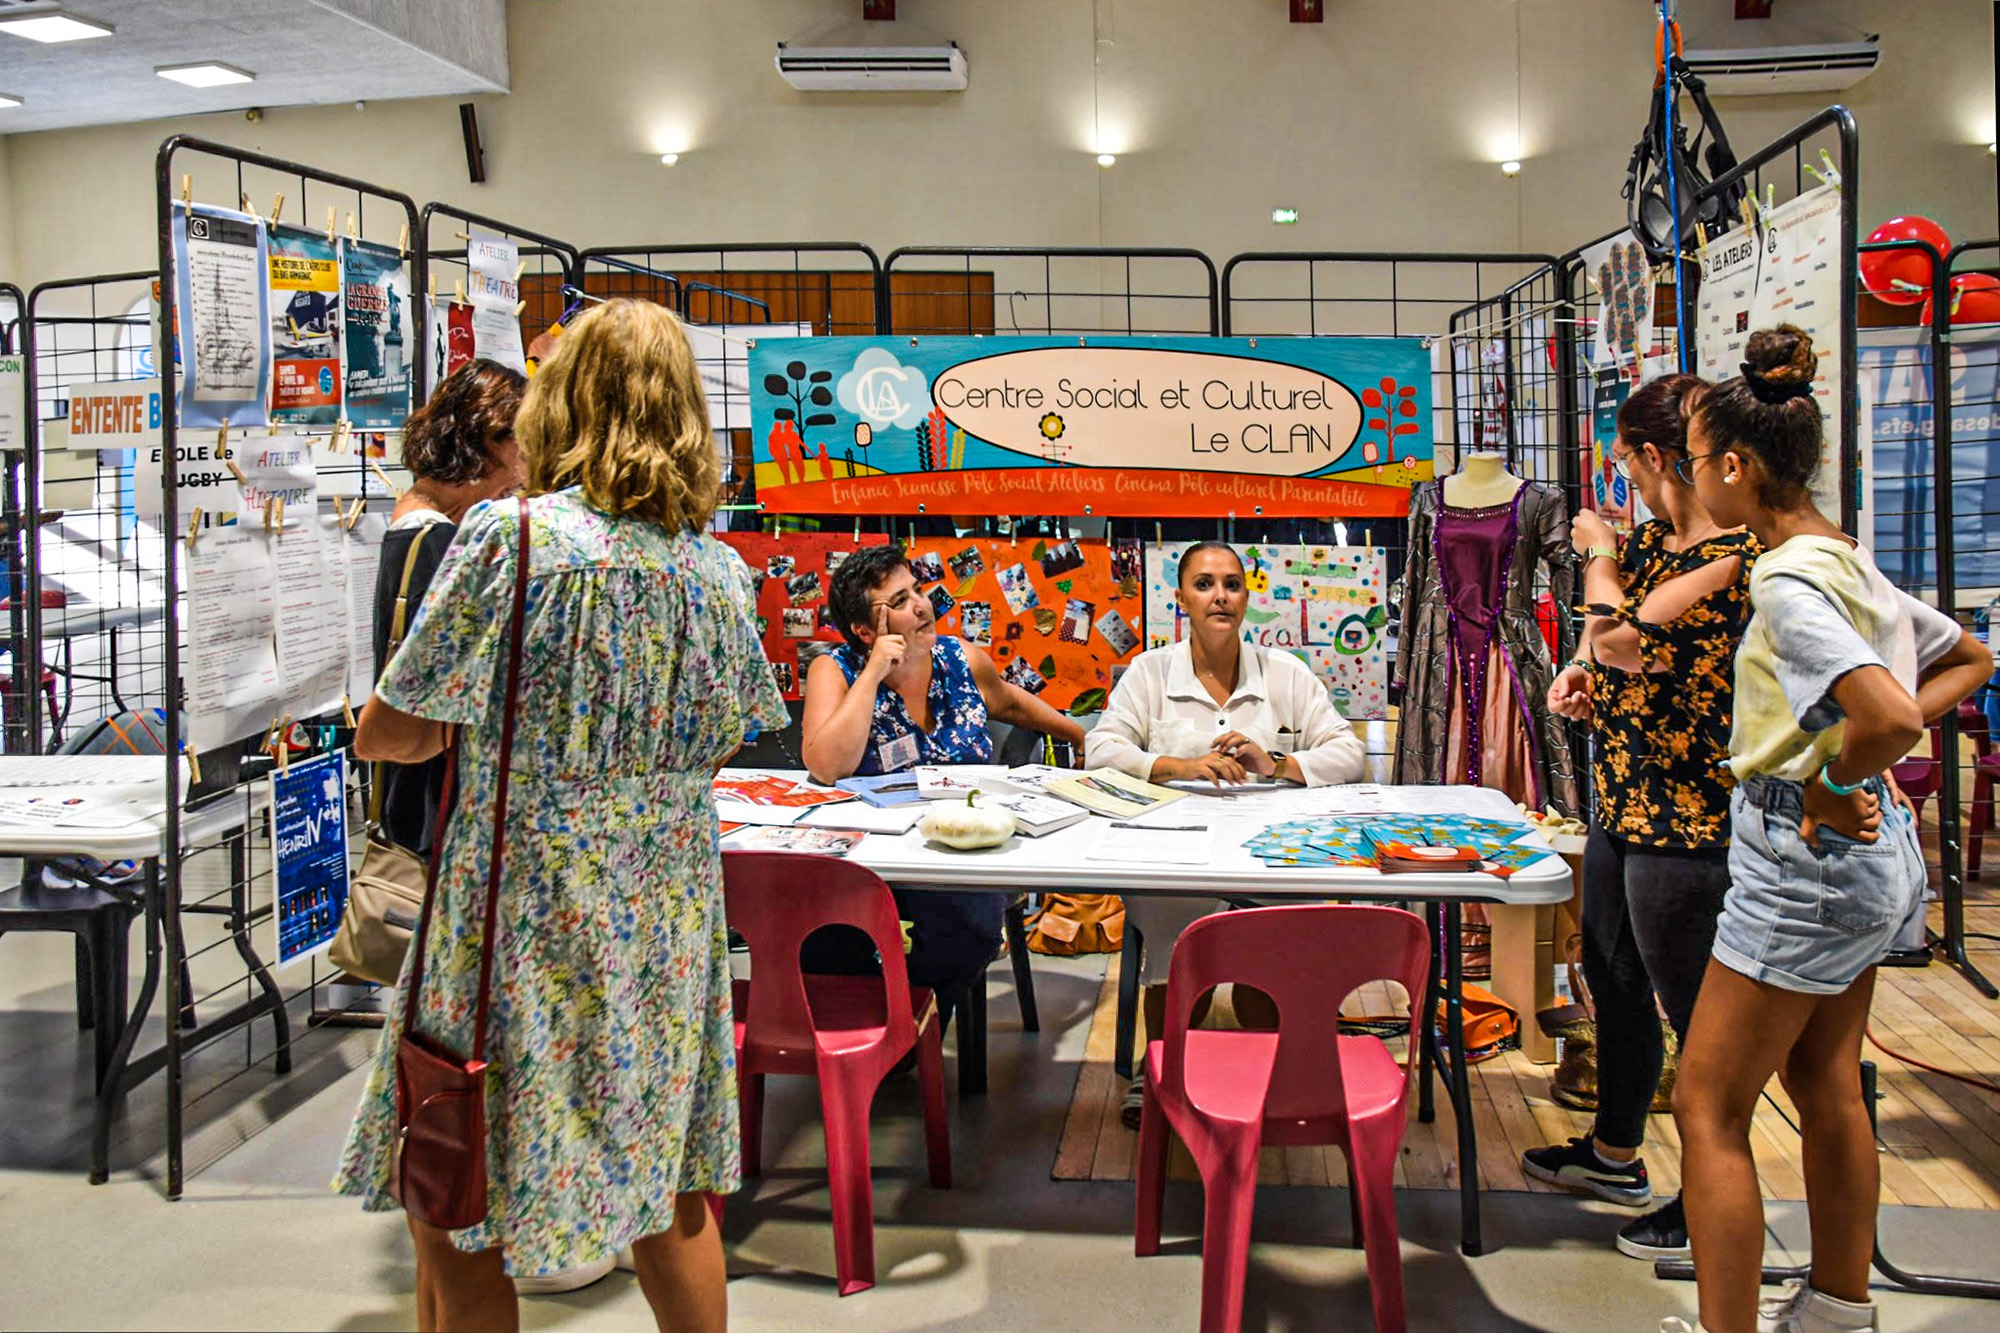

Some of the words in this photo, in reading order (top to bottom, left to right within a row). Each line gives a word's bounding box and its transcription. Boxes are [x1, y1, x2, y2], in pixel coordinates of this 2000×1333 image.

[479, 242, 509, 262] ATELIER
[1712, 253, 1723, 273] LES
[1723, 240, 1753, 268] ATELIERS
[356, 283, 386, 299] GRANDE
[471, 269, 517, 300] THEATRE
[347, 296, 387, 312] GUERRE
[939, 378, 1044, 409] Centre
[1056, 378, 1148, 409] Social
[1160, 379, 1191, 410] et
[1202, 379, 1333, 411] Culturel
[71, 395, 143, 435] ENTENTE
[1191, 423, 1229, 453] Le
[1241, 423, 1331, 453] CLAN
[151, 446, 208, 463] EOLE
[257, 450, 301, 468] ATELIER
[831, 481, 892, 506] Enfance
[898, 477, 958, 500] Jeunesse
[963, 473, 995, 494] Pôle
[1000, 473, 1042, 494] Social
[1048, 473, 1105, 494] Ateliers
[1115, 473, 1175, 493] Cinéma
[1180, 473, 1212, 496] Pôle
[1216, 478, 1276, 501] culturel
[1282, 481, 1368, 507] Parentalité
[277, 830, 308, 859] HENRI
[306, 808, 323, 846] IV
